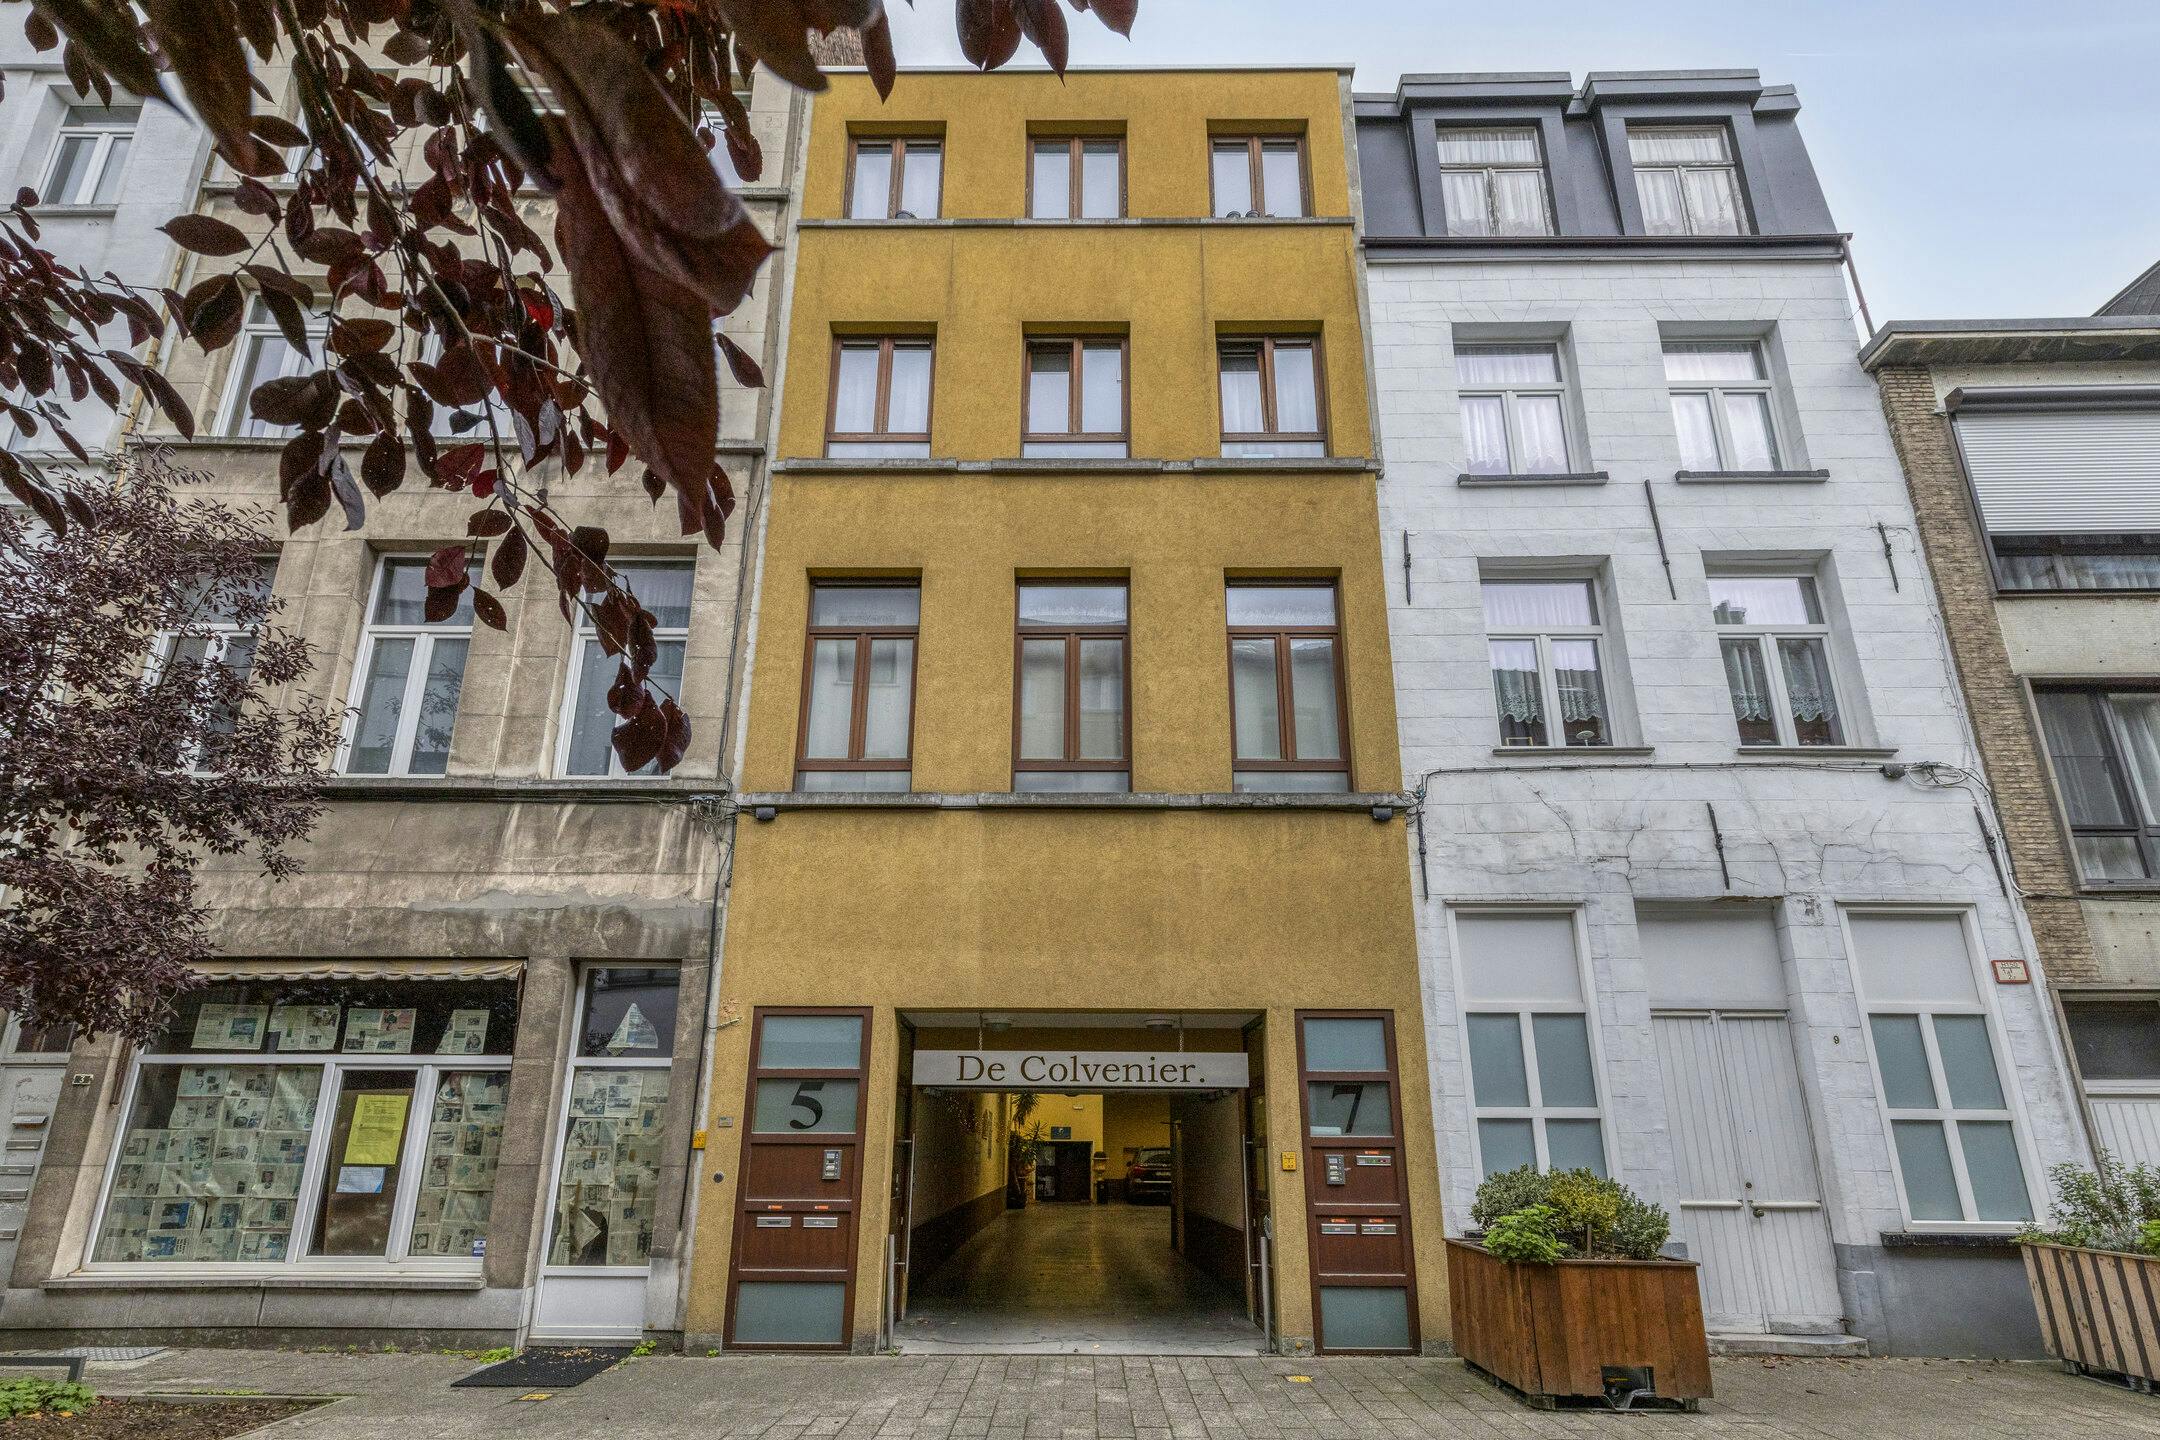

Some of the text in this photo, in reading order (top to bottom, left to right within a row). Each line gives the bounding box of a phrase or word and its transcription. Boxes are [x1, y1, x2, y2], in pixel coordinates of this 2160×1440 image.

[956, 1055, 1206, 1084] De Colvenier.
[789, 1081, 826, 1130] 5
[1331, 1084, 1365, 1134] 7
